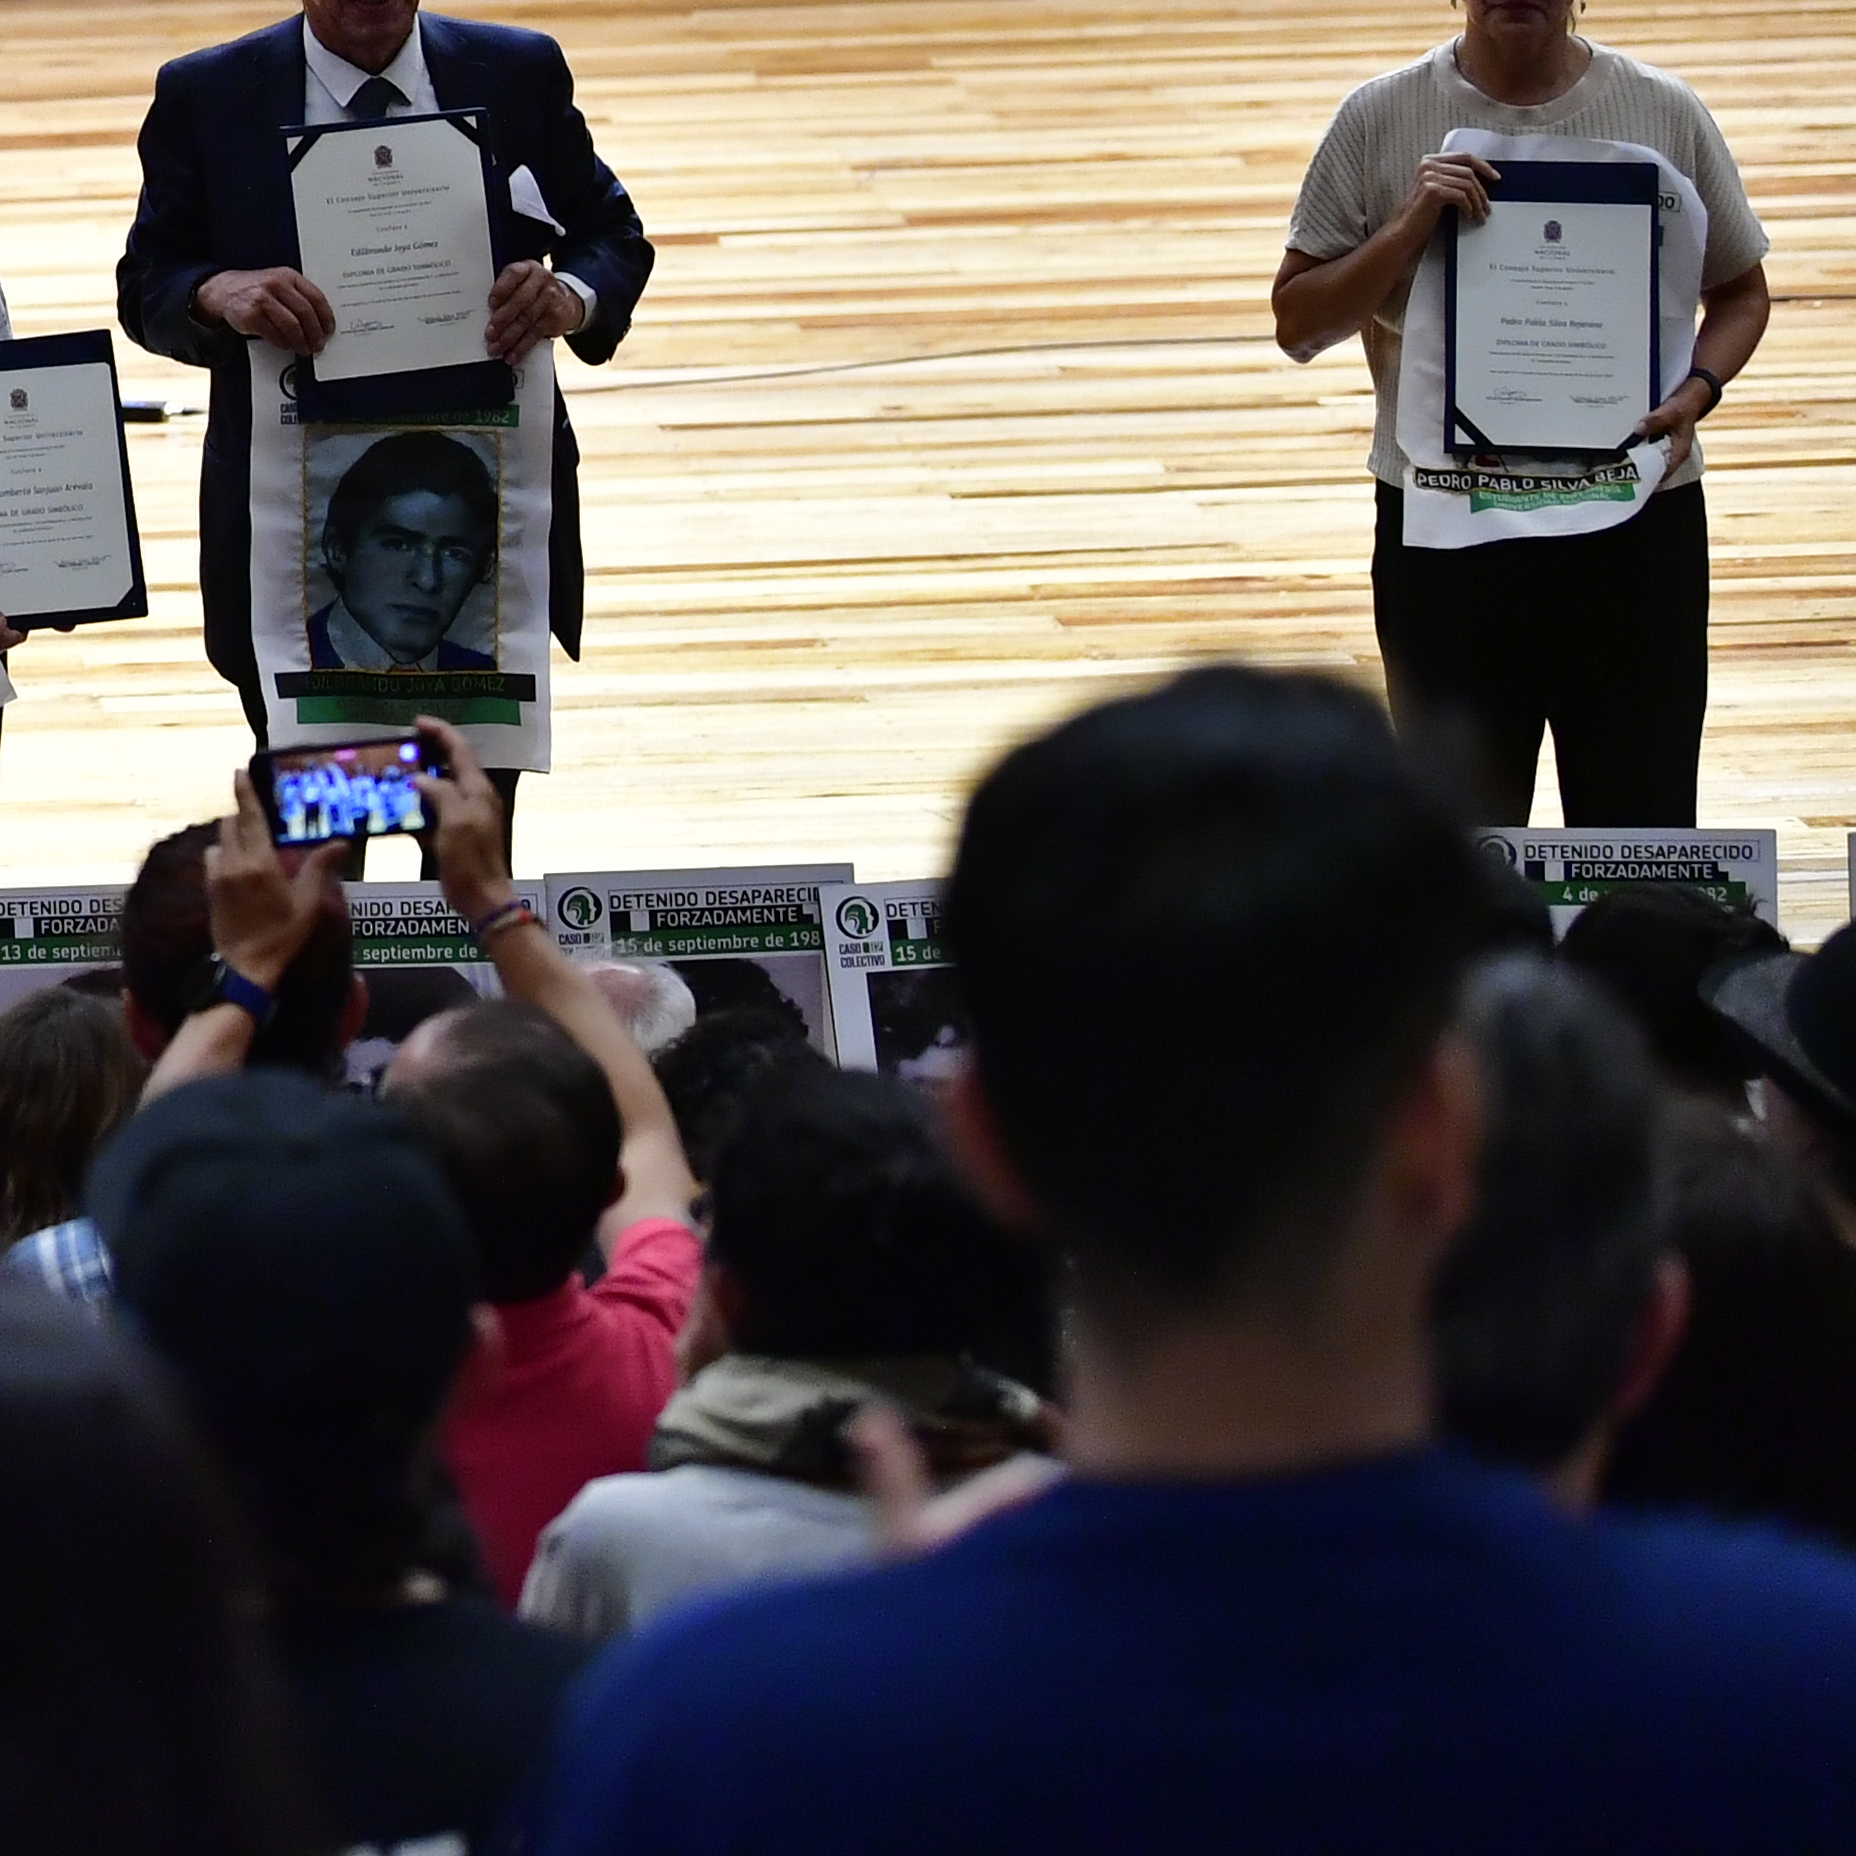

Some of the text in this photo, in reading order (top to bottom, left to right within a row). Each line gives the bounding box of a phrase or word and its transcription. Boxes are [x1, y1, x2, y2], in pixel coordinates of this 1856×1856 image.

[336, 195, 365, 203] Consejo
[368, 191, 399, 200] Superior
[473, 408, 510, 425] 1982
[3, 434, 32, 442] Superior
[1418, 466, 1637, 492] PEDRO PABLO SILVA BEJA
[1525, 844, 1753, 860] DETENIDO DESAPARECIDO
[1571, 864, 1713, 879] FORZADAMENTE
[610, 891, 698, 910] DETENIDO
[1562, 887, 1573, 901] 4
[1579, 887, 1598, 902] de
[351, 901, 393, 917] NIDO
[656, 907, 798, 927] FORZADAMENTE
[887, 901, 941, 918] DETEN
[41, 917, 120, 935] FORZADA
[352, 919, 470, 936] FORZADAMEN
[559, 934, 582, 945] CASO
[618, 937, 637, 954] 15
[644, 937, 663, 952] de
[669, 932, 760, 954] septiembre
[765, 932, 784, 948] de
[790, 930, 821, 947] 198
[1, 944, 22, 961] 13
[28, 944, 47, 959] de
[363, 944, 478, 962] septiembre de
[839, 943, 861, 955] CASO
[896, 946, 941, 962] 15 de
[840, 955, 885, 968] COLECTIVO
